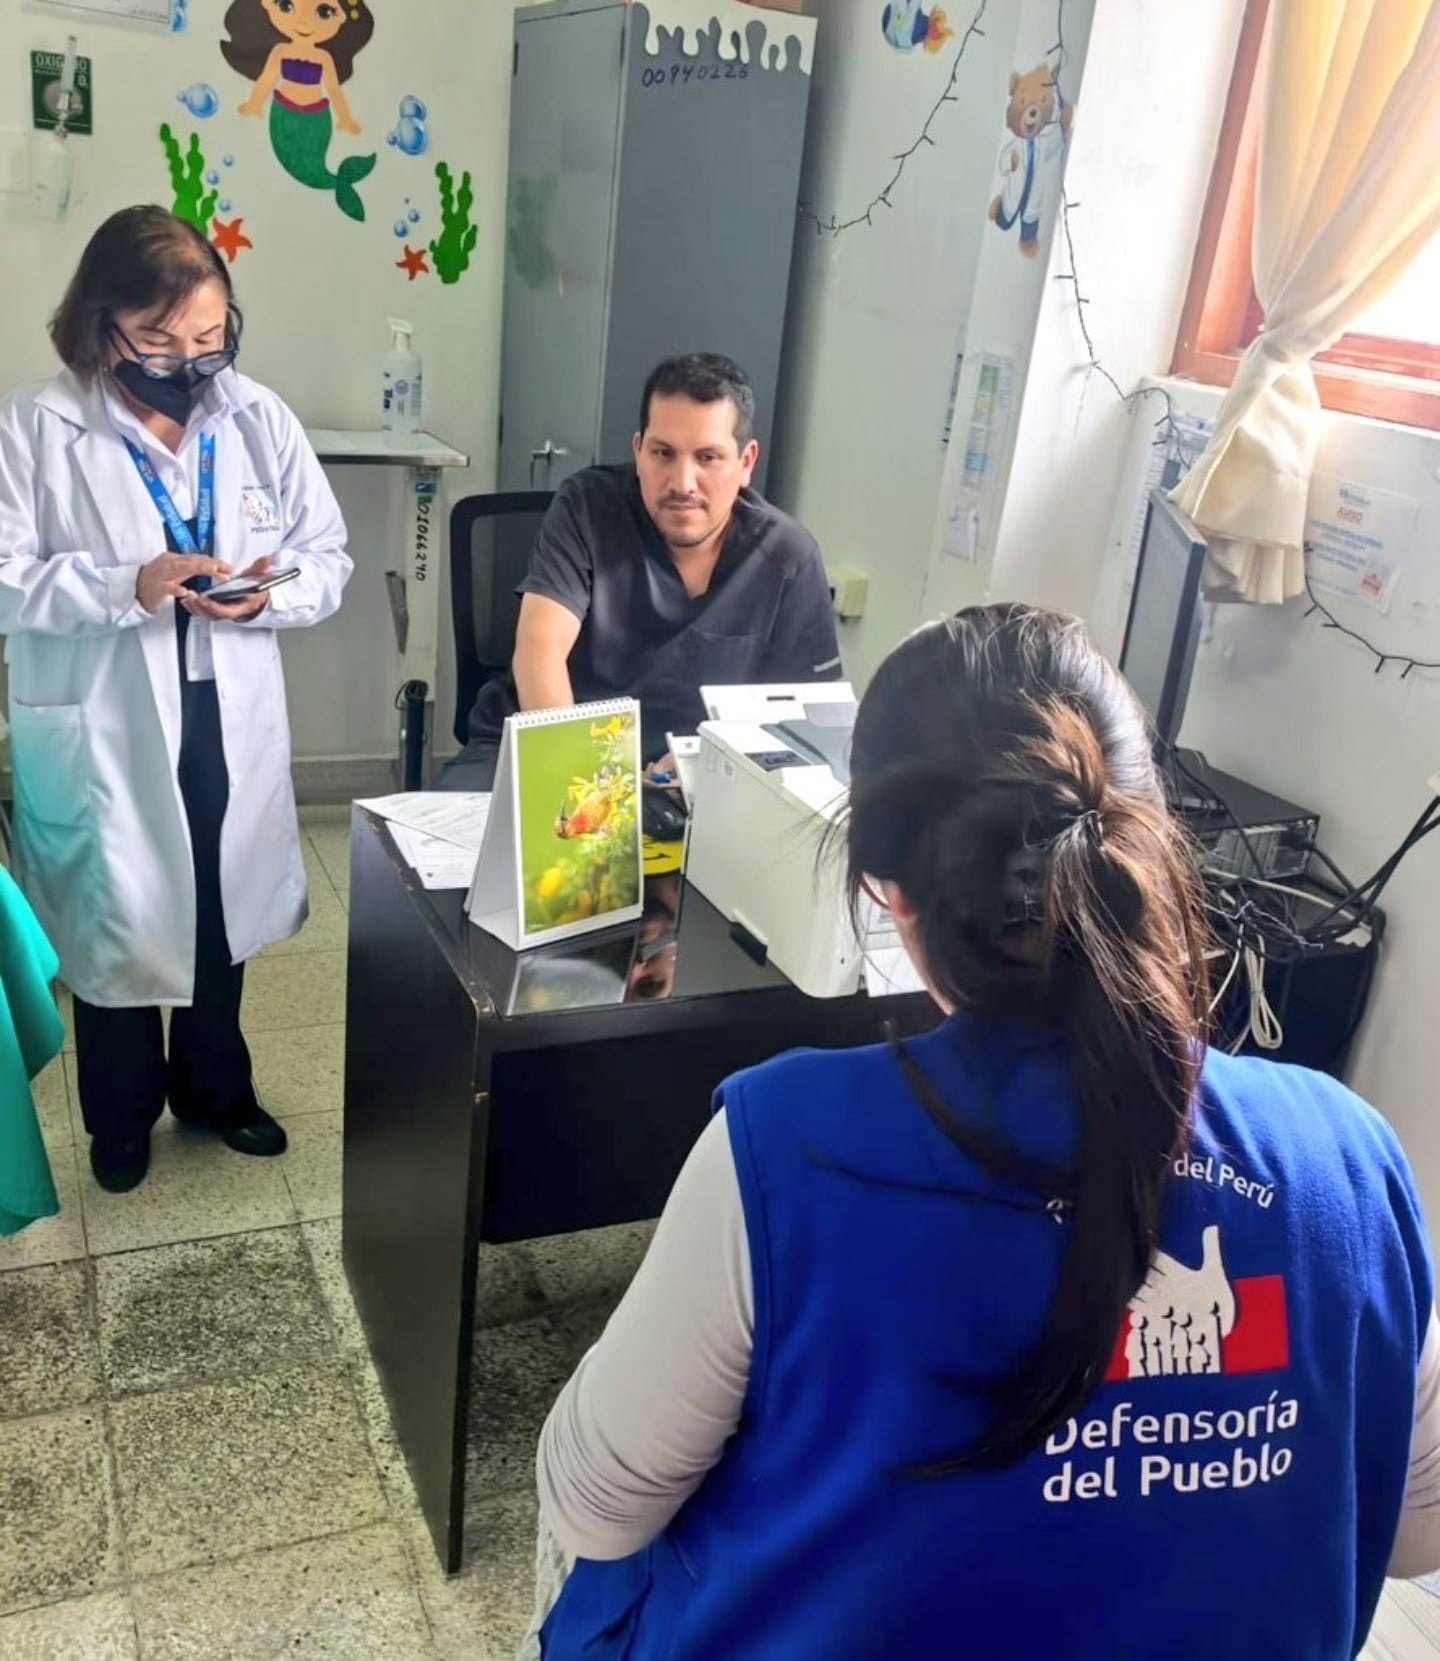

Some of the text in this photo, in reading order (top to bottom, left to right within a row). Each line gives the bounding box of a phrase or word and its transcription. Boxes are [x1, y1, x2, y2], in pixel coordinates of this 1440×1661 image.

[1174, 1154, 1275, 1209] del Perú
[1045, 1390, 1299, 1455] Defensoría
[1043, 1442, 1293, 1503] del Pueblo
